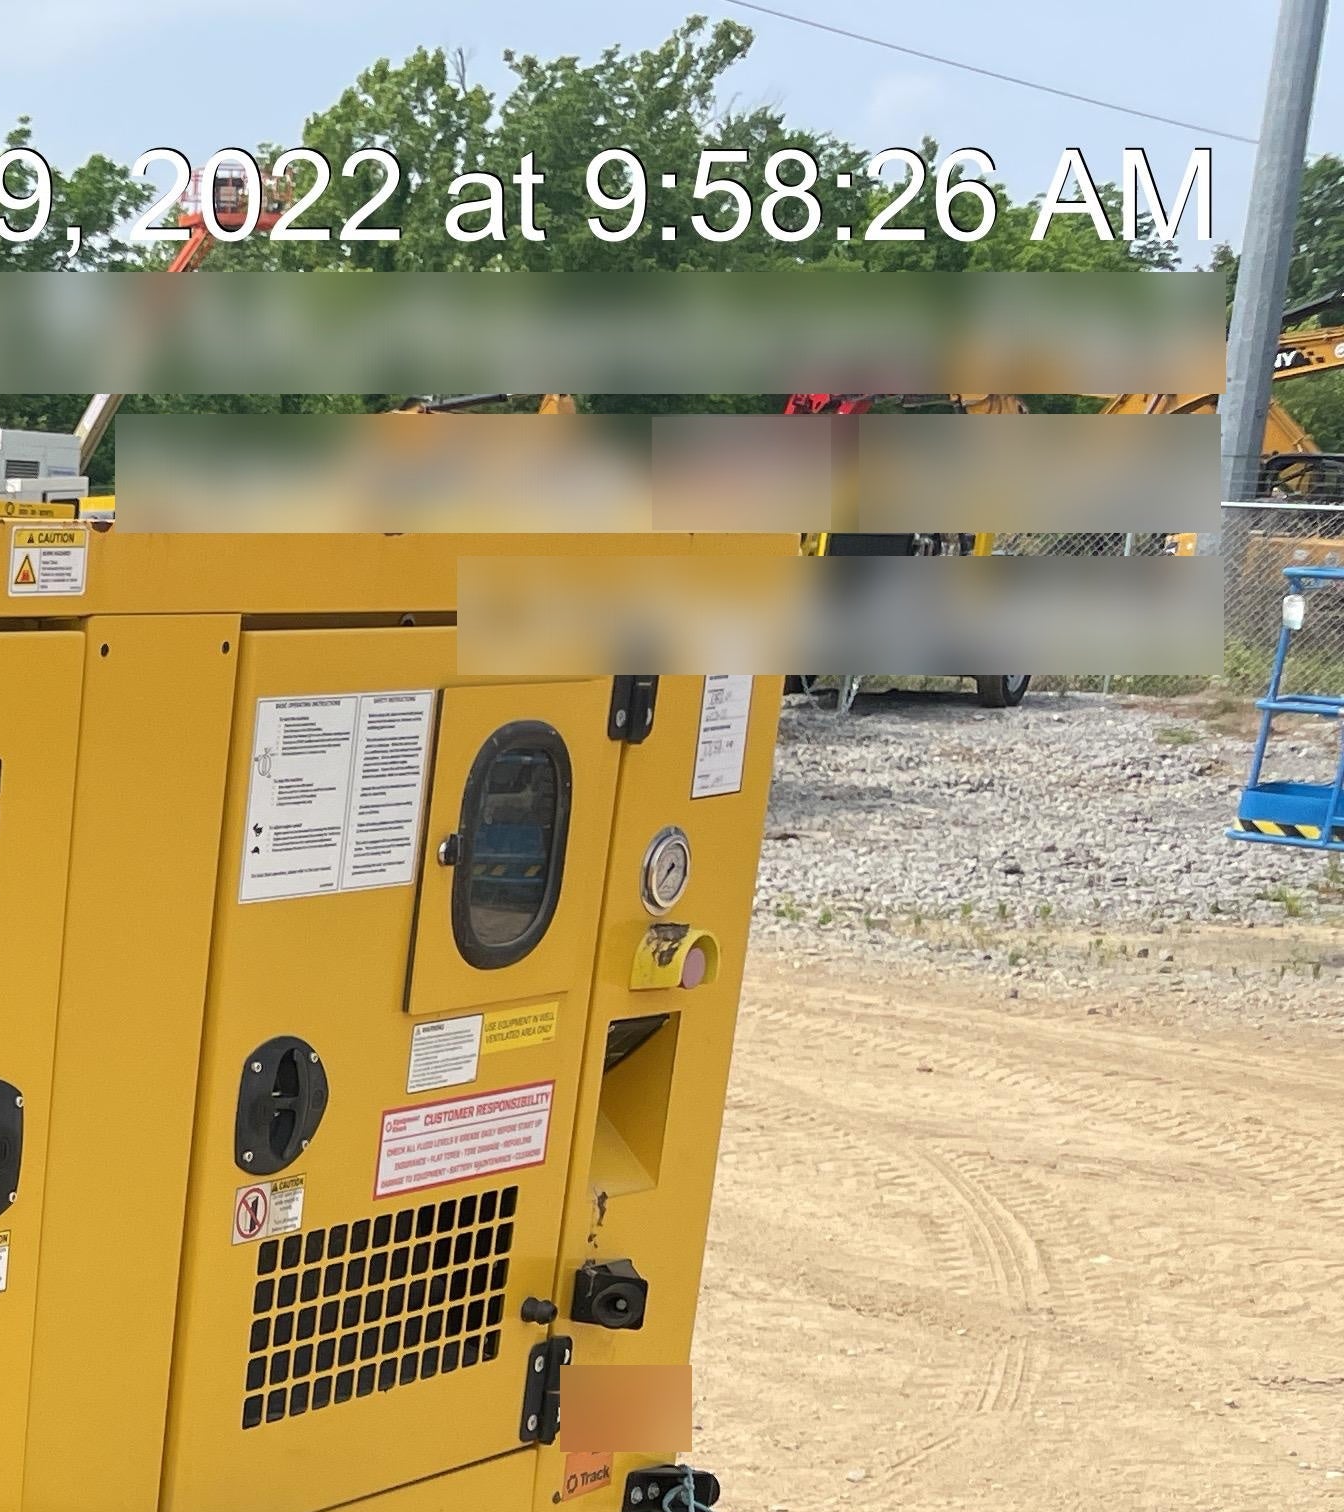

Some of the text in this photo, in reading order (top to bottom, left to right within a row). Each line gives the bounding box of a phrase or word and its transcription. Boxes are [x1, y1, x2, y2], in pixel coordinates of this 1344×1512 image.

[38, 533, 75, 543] CAUTION
[498, 1017, 532, 1030] EQUIPMENT
[486, 1023, 553, 1044] VENTILATED AREA ONLY
[424, 1091, 551, 1127] CUSTOMER RESPONSIBILITY
[279, 1178, 304, 1191] CAUTION
[580, 1464, 610, 1487] Track
